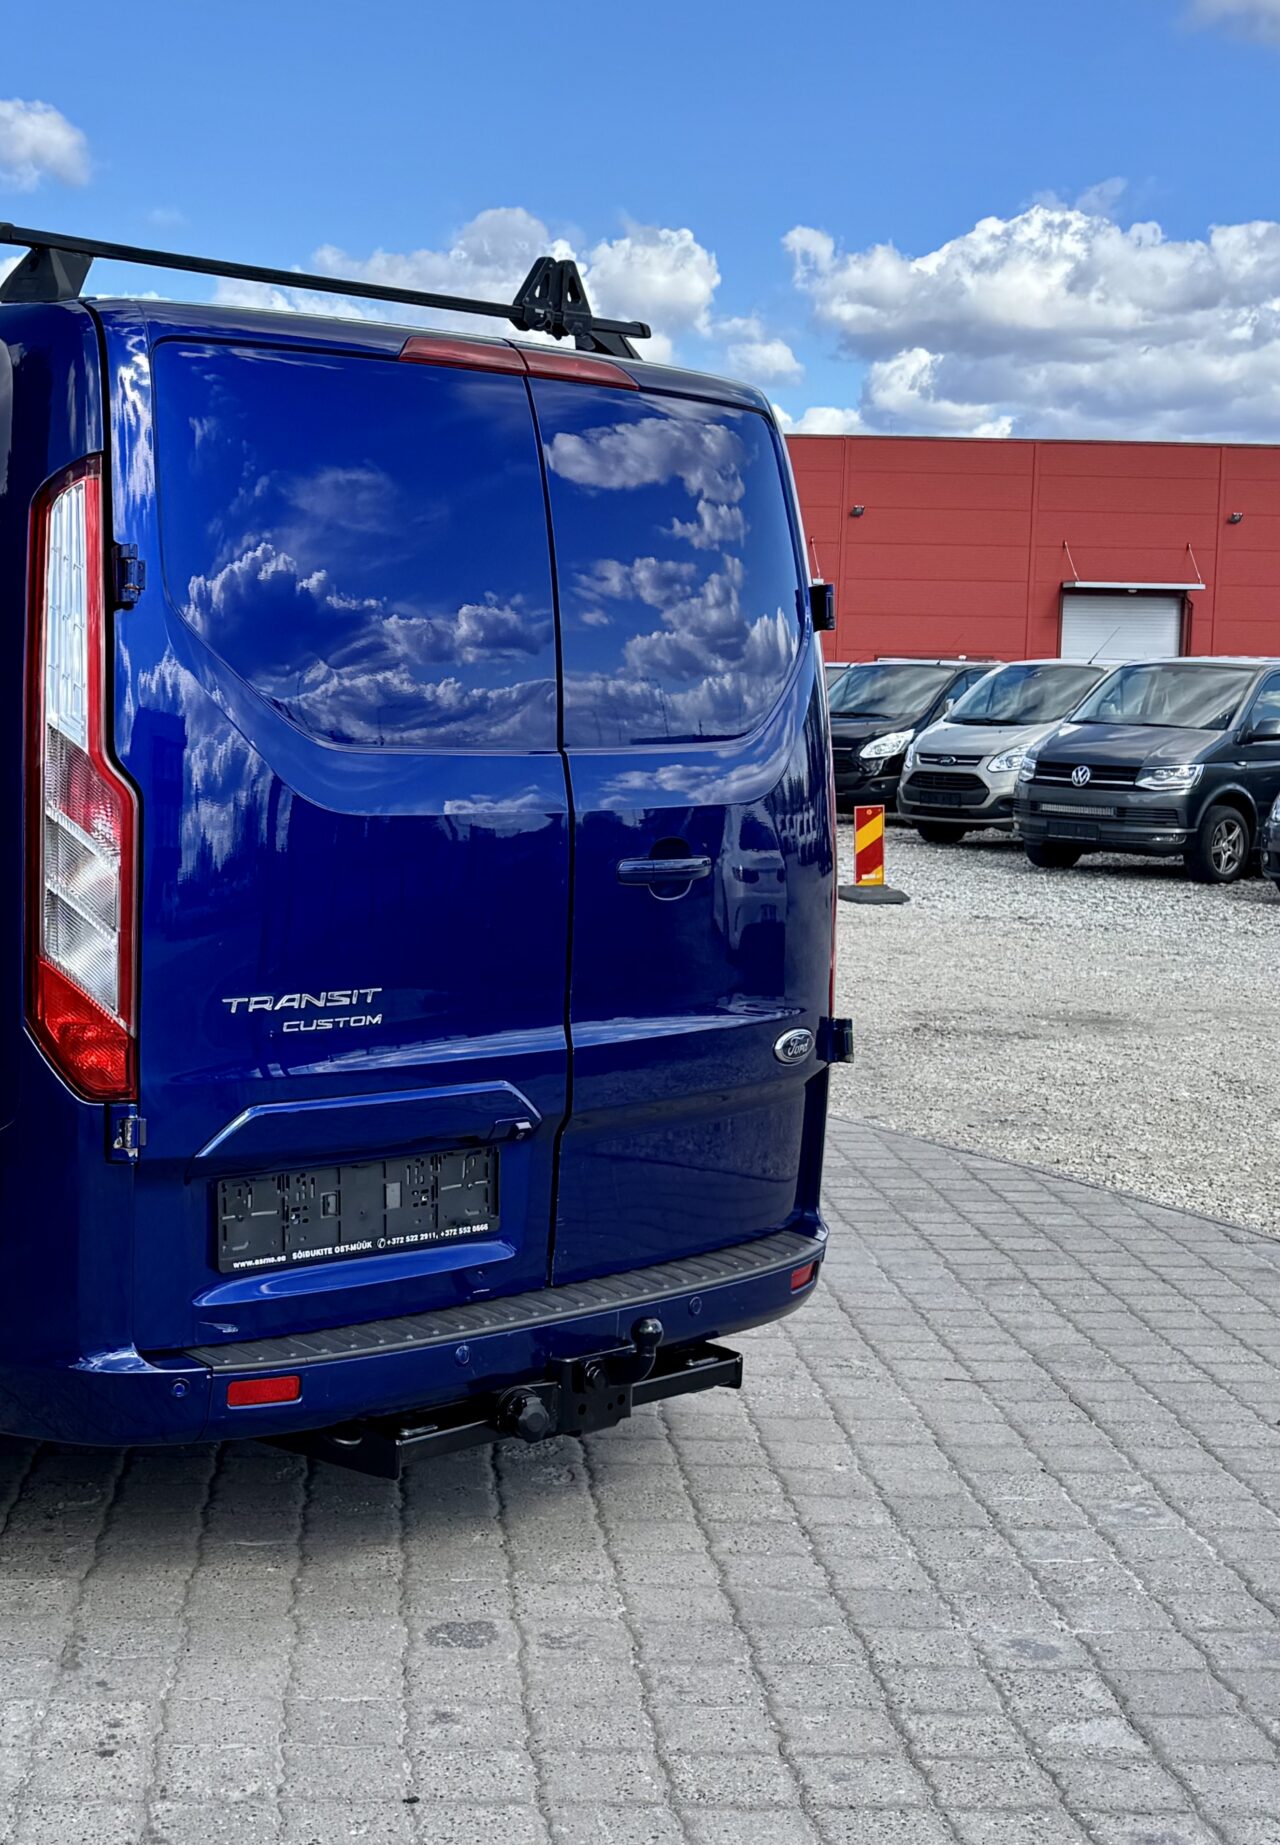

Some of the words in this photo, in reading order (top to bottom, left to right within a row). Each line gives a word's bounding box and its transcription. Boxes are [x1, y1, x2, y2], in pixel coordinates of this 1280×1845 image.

[222, 987, 382, 1013] TRANSIT
[282, 1013, 382, 1032] CUSTOM
[787, 1035, 810, 1057] Ford
